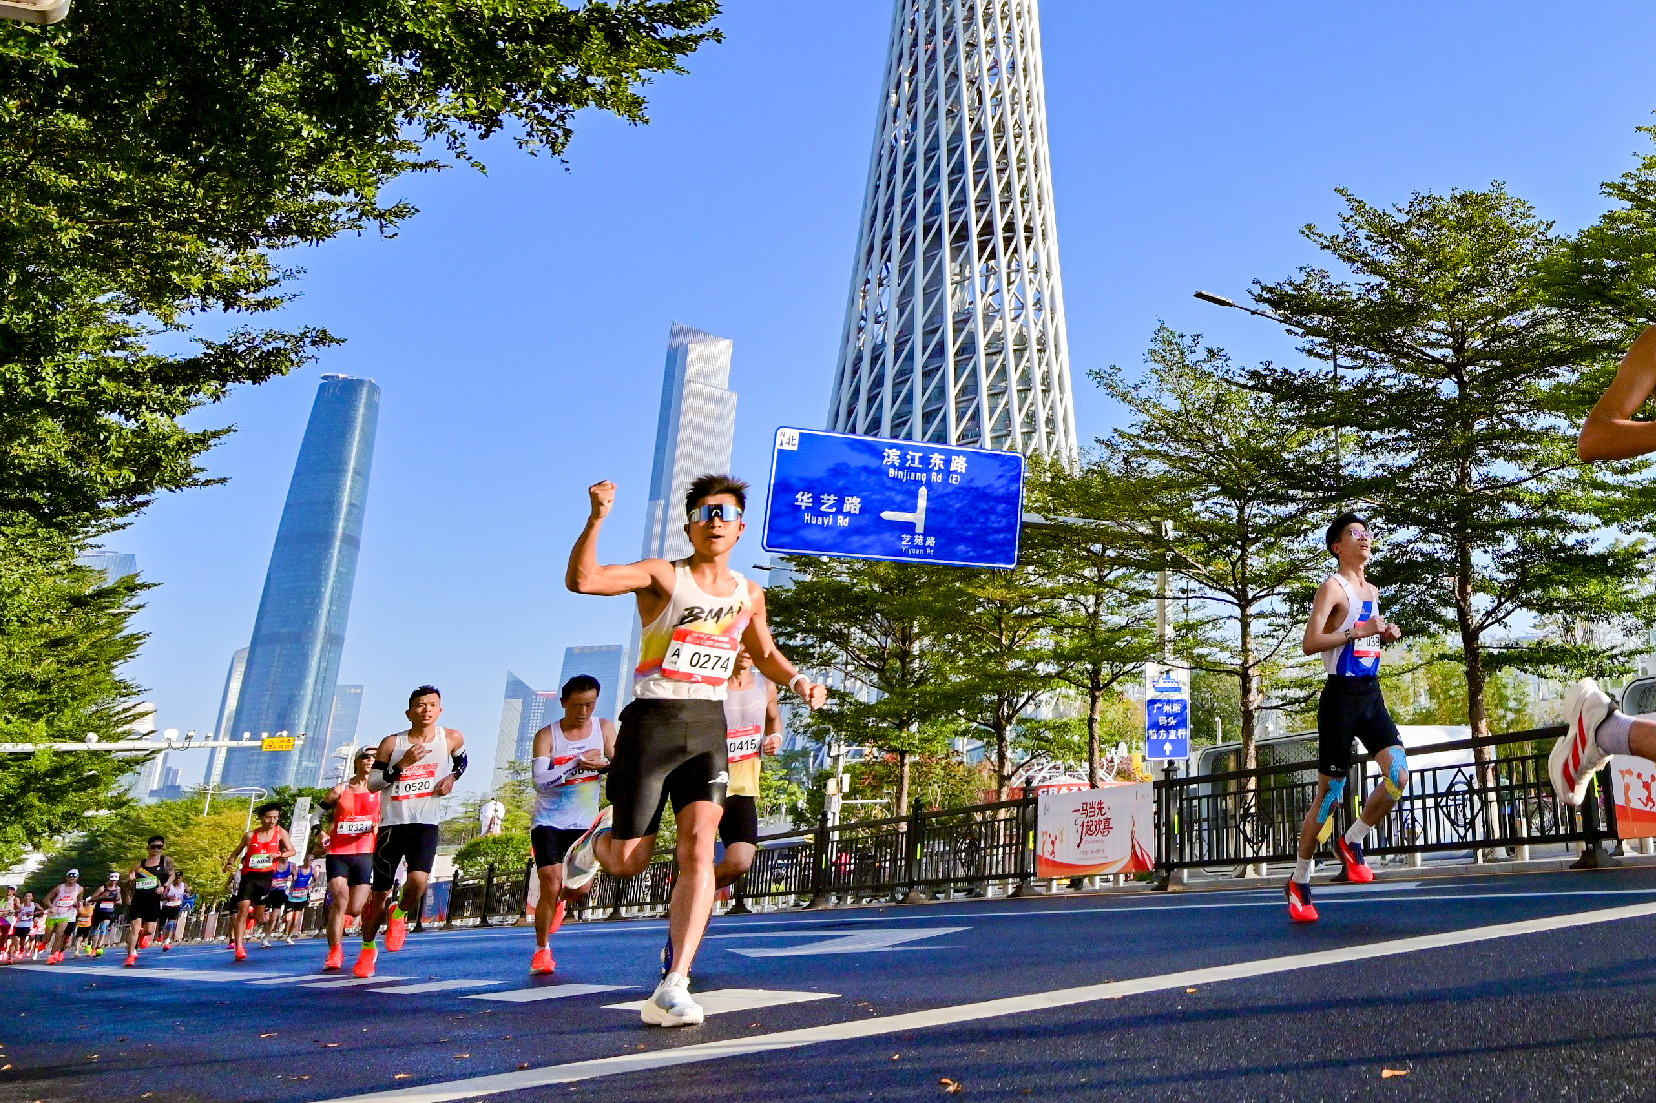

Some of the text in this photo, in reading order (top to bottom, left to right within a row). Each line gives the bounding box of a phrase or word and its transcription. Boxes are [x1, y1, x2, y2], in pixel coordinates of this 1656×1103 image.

[785, 435, 797, 447] 北
[882, 448, 968, 473] 滨江东路
[888, 468, 961, 485] Binjiang Rd (E)
[794, 491, 862, 515] 华艺路
[804, 512, 850, 528] Huayi Rd
[671, 648, 731, 673] A 0274
[729, 738, 758, 753] 0415
[404, 780, 431, 793] 0520
